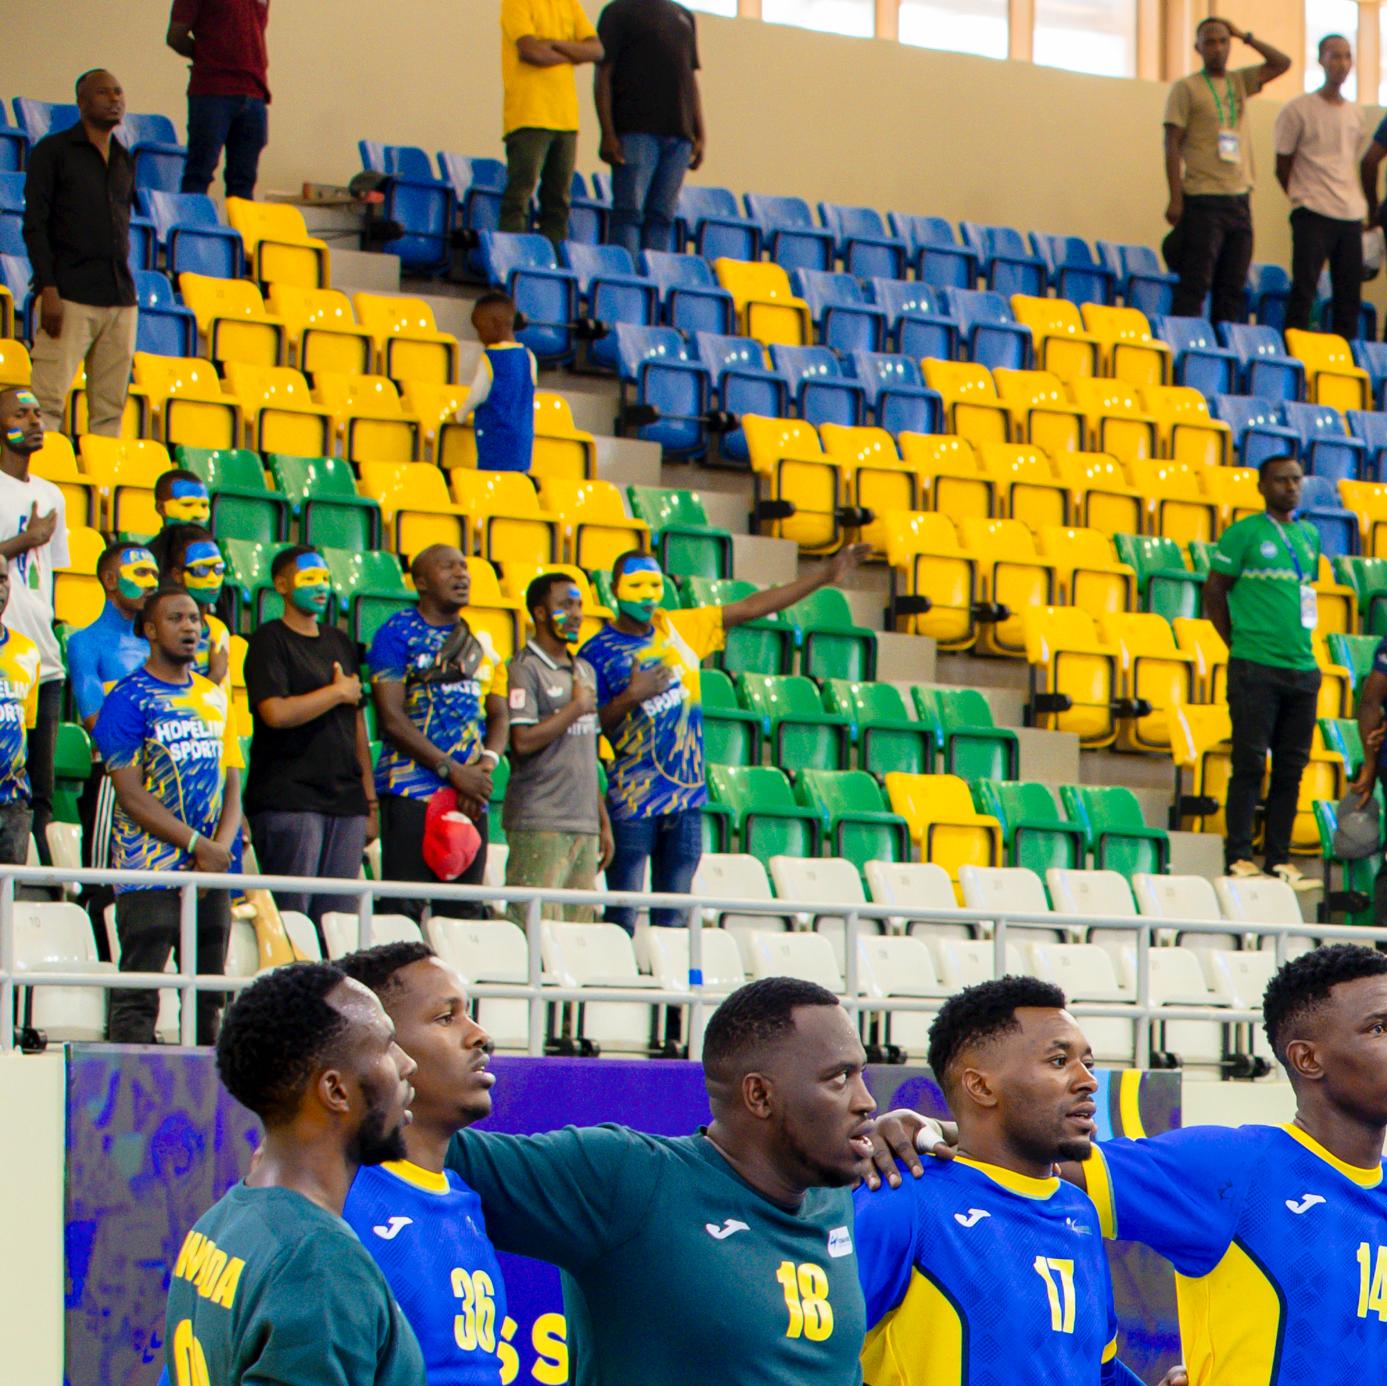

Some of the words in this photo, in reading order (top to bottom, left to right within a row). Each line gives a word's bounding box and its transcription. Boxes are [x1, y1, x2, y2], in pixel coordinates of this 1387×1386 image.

[451, 1268, 496, 1353] 36
[776, 1260, 834, 1342] 18
[1033, 1255, 1076, 1334] 17
